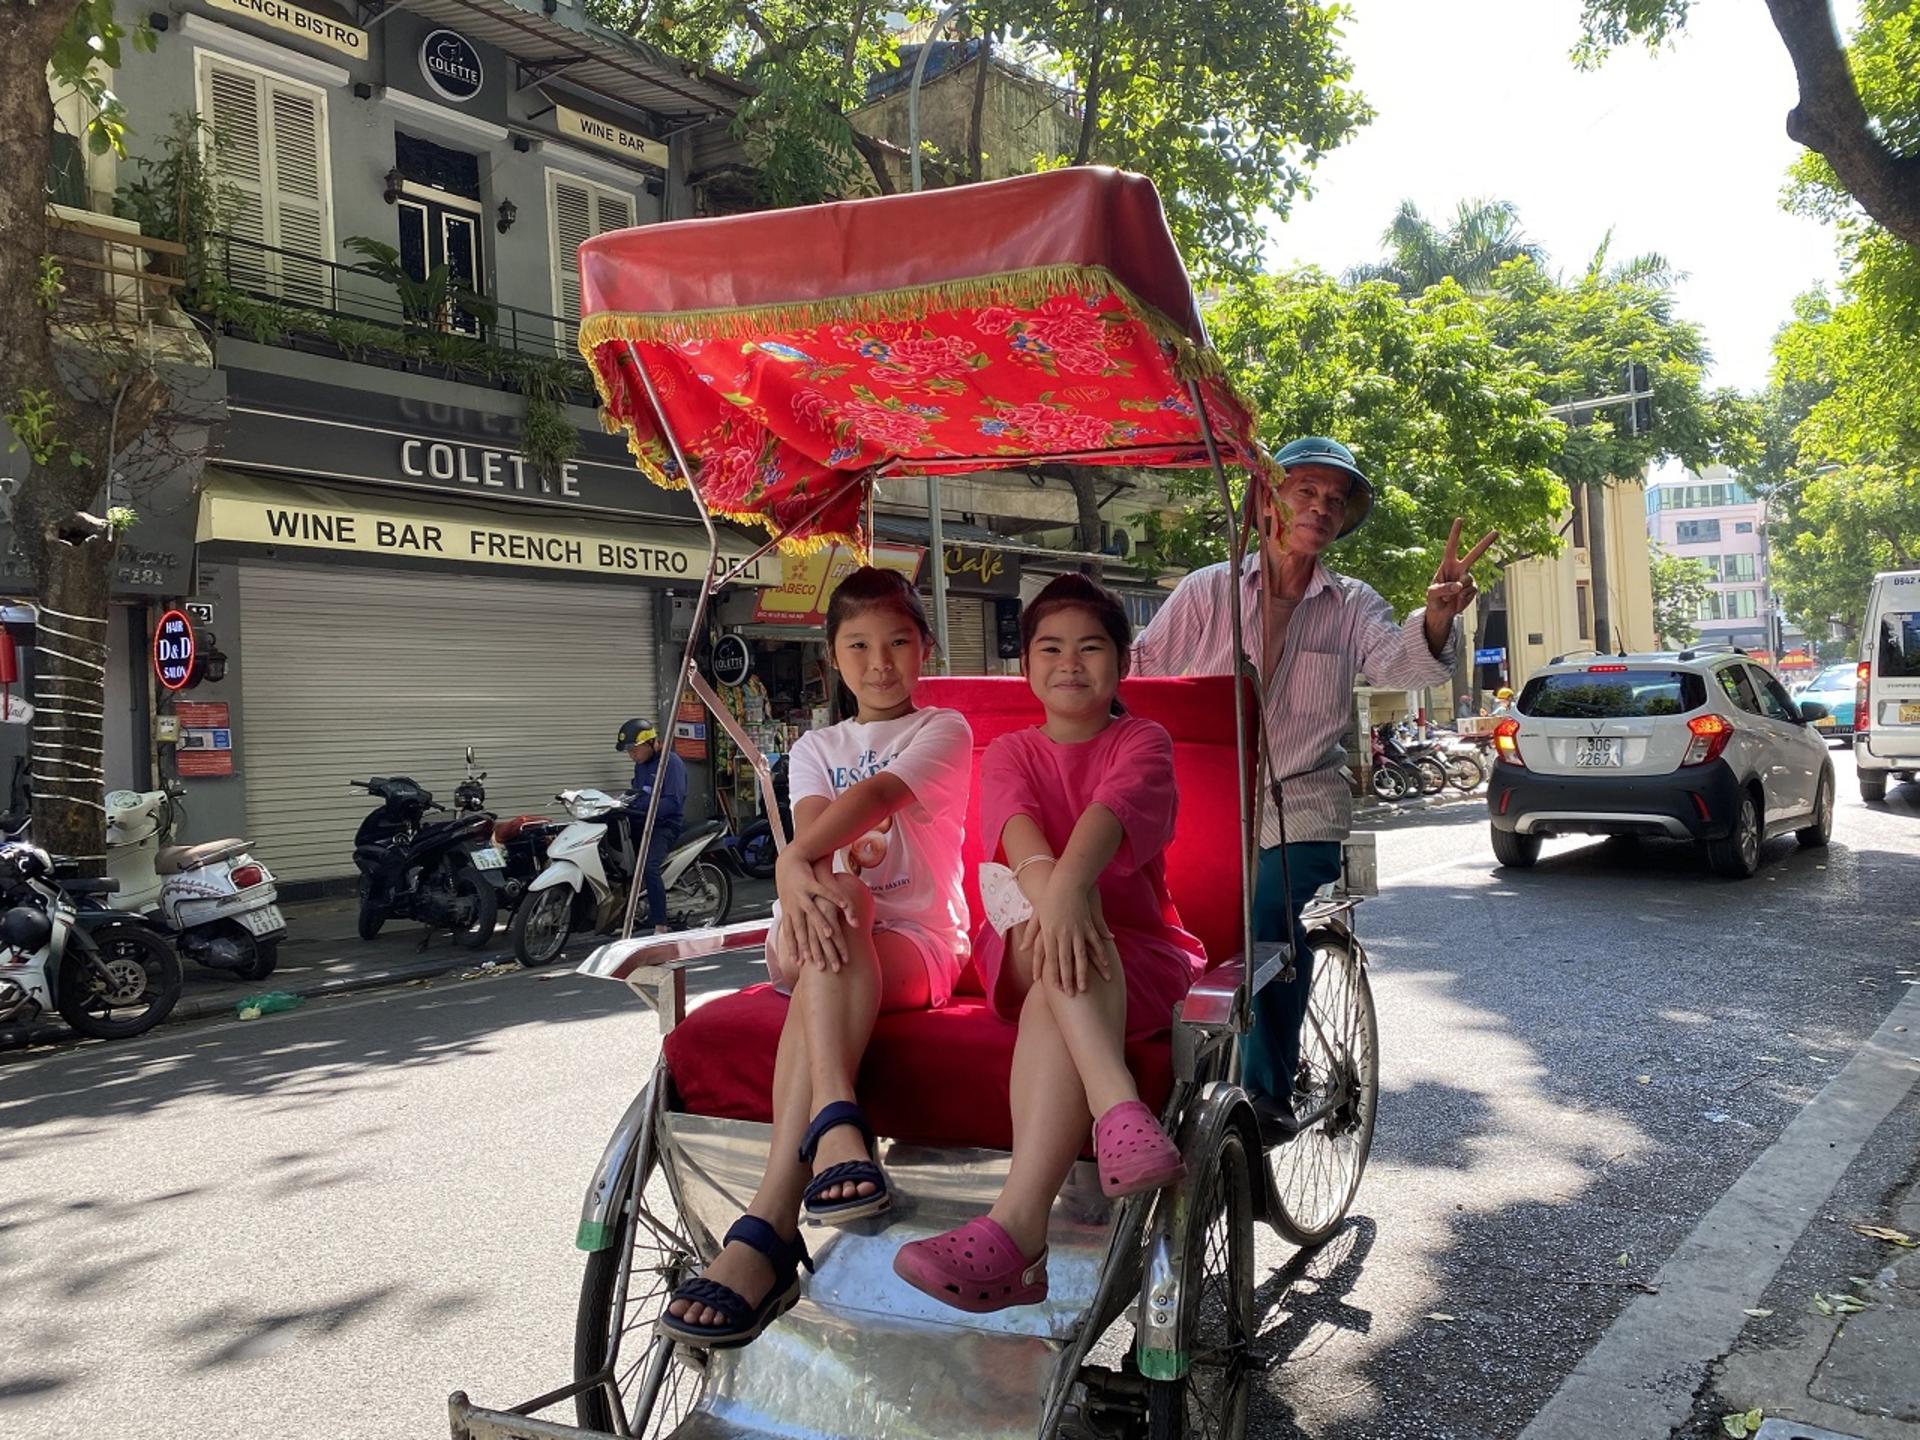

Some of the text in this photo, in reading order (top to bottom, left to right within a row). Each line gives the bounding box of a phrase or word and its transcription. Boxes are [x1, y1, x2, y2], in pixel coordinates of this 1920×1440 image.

[232, 0, 359, 48] ENCH BISTRO
[428, 56, 478, 83] COLETTE
[580, 118, 645, 153] WINE BAR
[266, 509, 356, 544] WINE
[376, 521, 444, 551] BAR
[470, 530, 582, 564] FRENCH
[599, 543, 688, 574] BISTRO
[943, 543, 1004, 583] Café
[166, 620, 184, 634] HAIR
[159, 636, 191, 661] D&D
[164, 665, 187, 679] SALON
[1587, 738, 1611, 752] 30G
